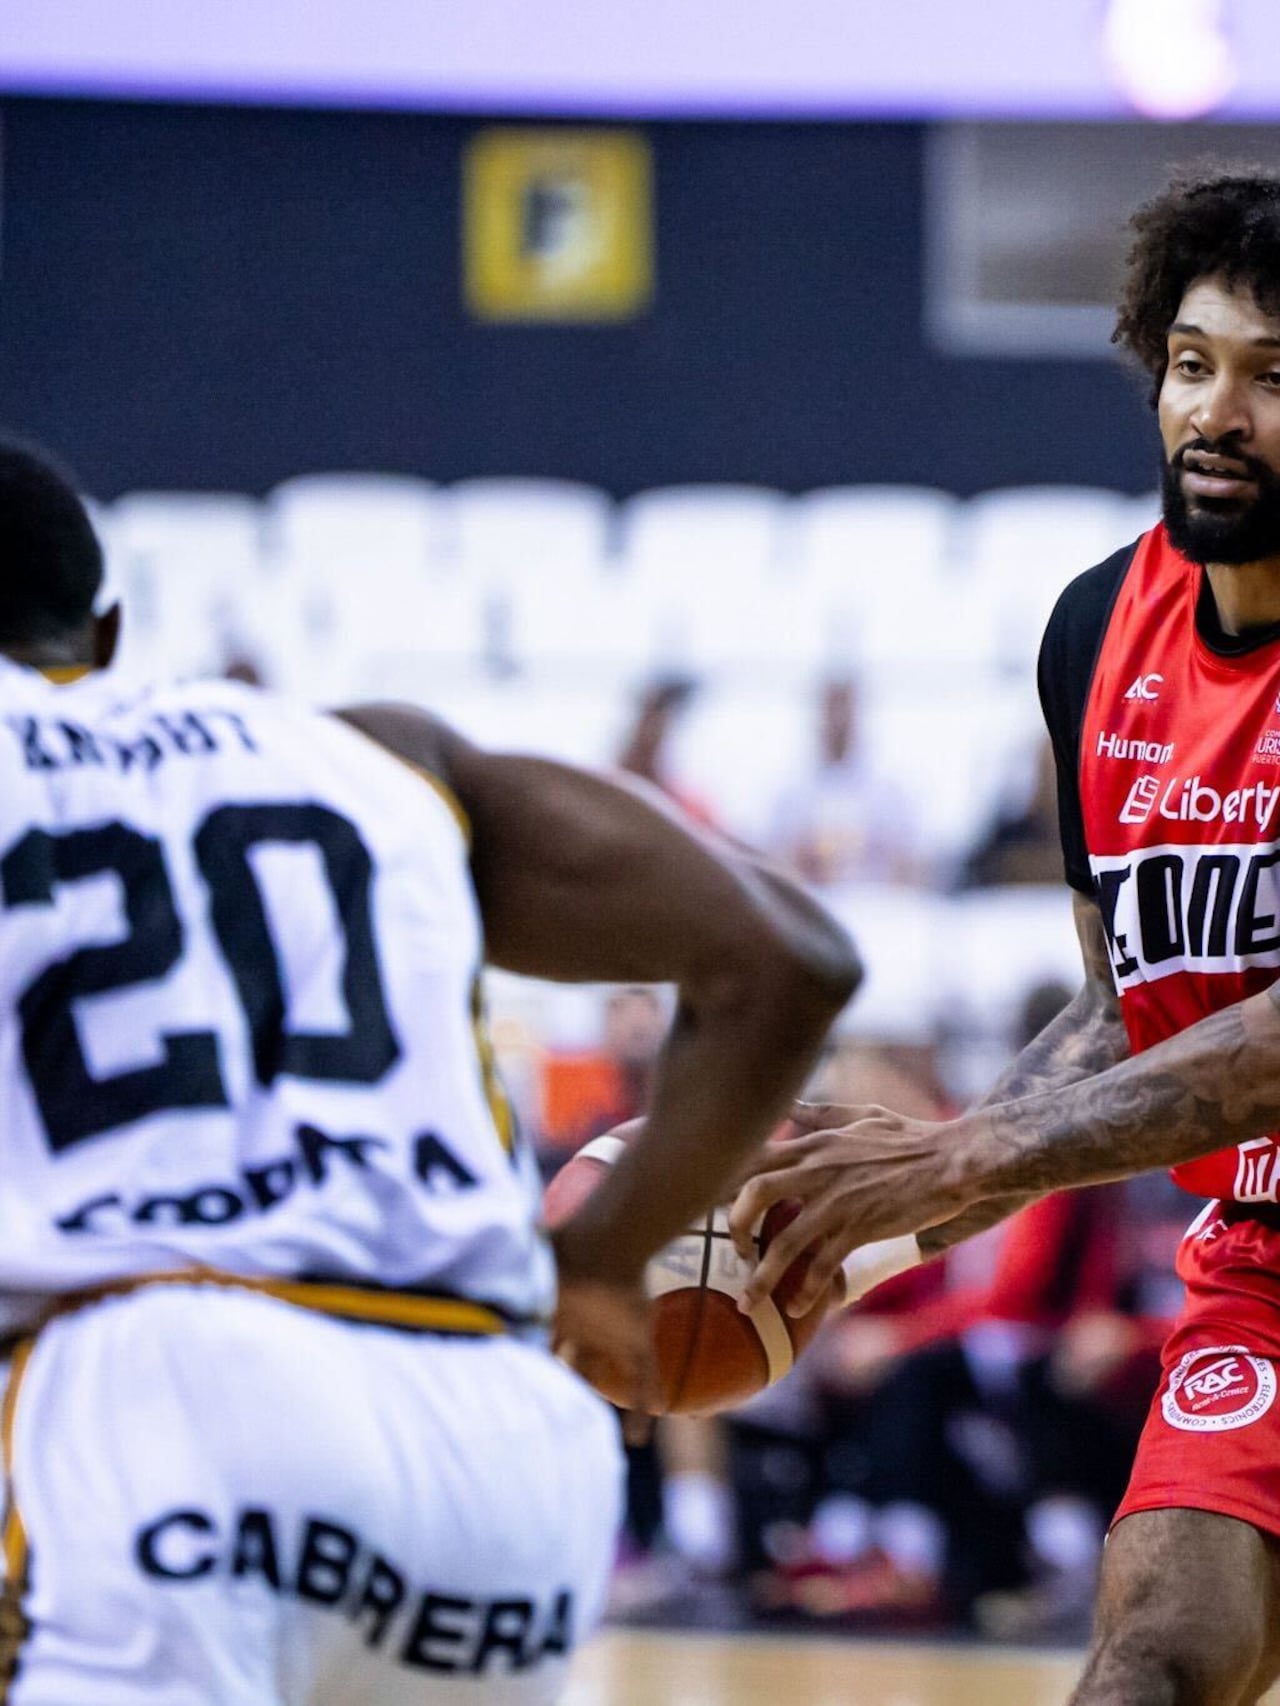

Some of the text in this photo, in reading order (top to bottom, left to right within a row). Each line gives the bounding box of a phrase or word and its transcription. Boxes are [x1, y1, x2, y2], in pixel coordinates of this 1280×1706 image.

[1124, 673, 1164, 700] AC
[1096, 731, 1175, 764] Human
[1159, 776, 1280, 832] Liberty
[0, 802, 402, 1157] 20
[1183, 1357, 1245, 1400] RAC
[136, 1507, 573, 1677] CABRERA
